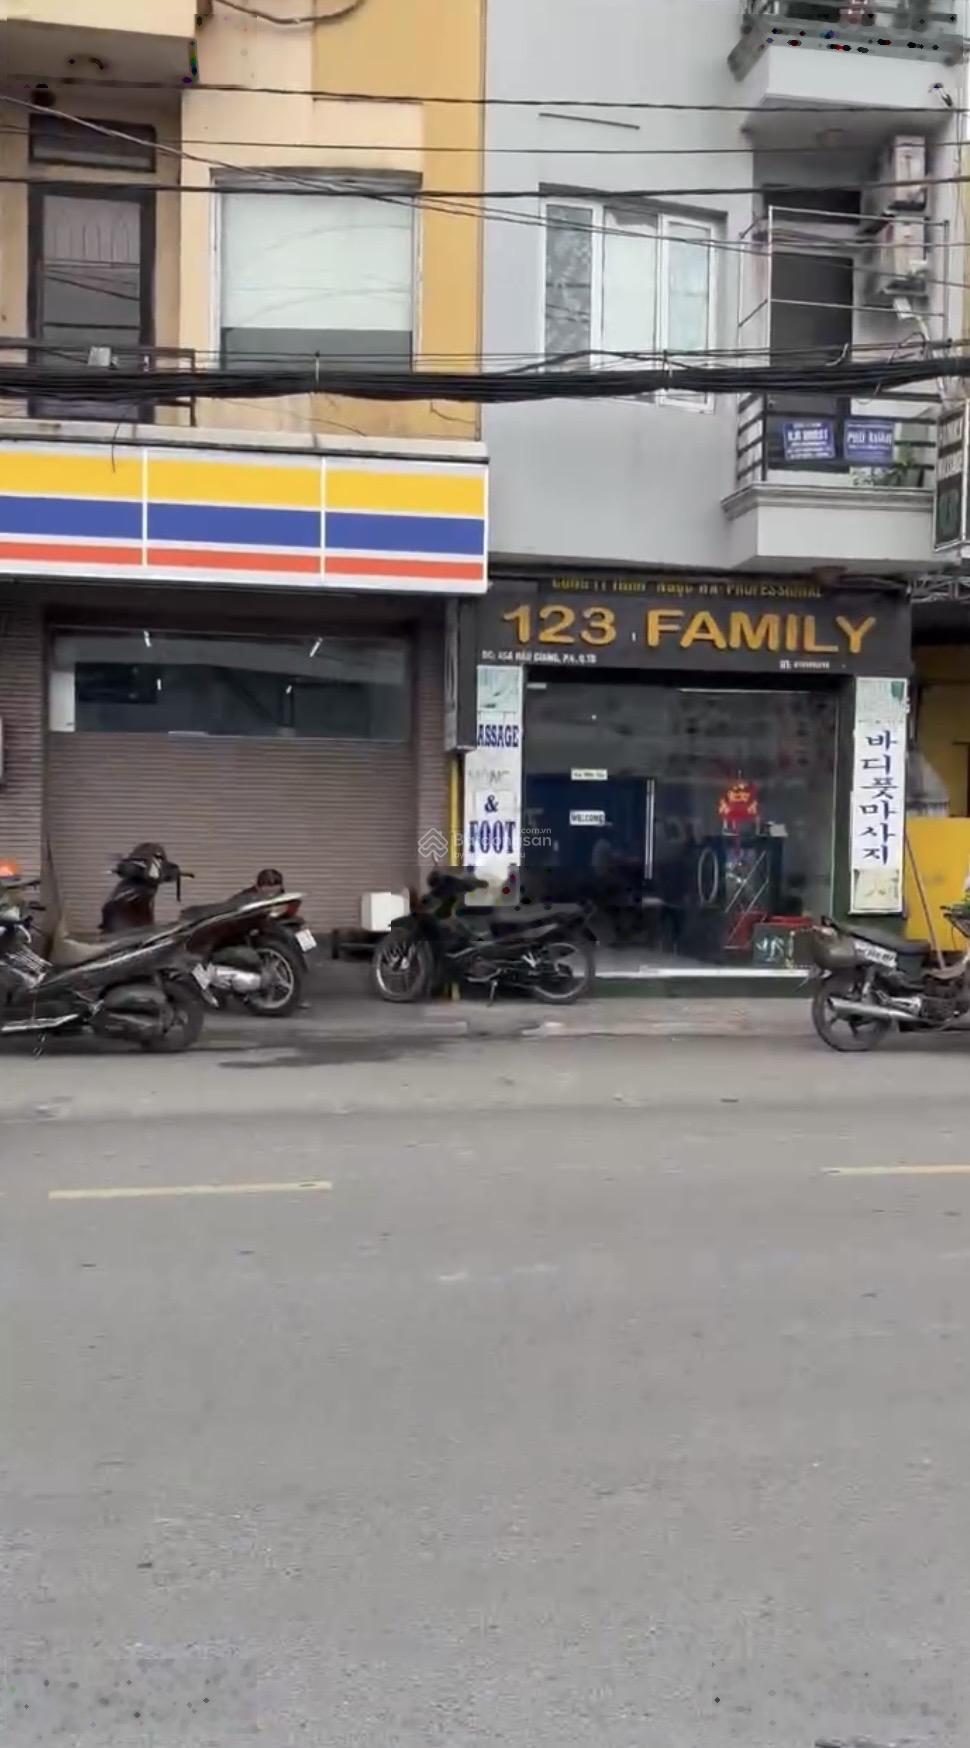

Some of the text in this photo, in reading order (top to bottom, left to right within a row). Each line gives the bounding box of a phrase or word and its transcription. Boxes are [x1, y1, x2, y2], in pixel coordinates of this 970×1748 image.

[503, 604, 877, 654] 123 FAMILY
[477, 724, 519, 748] ASSAGE
[484, 794, 499, 813] &
[469, 820, 516, 854] FOOT
